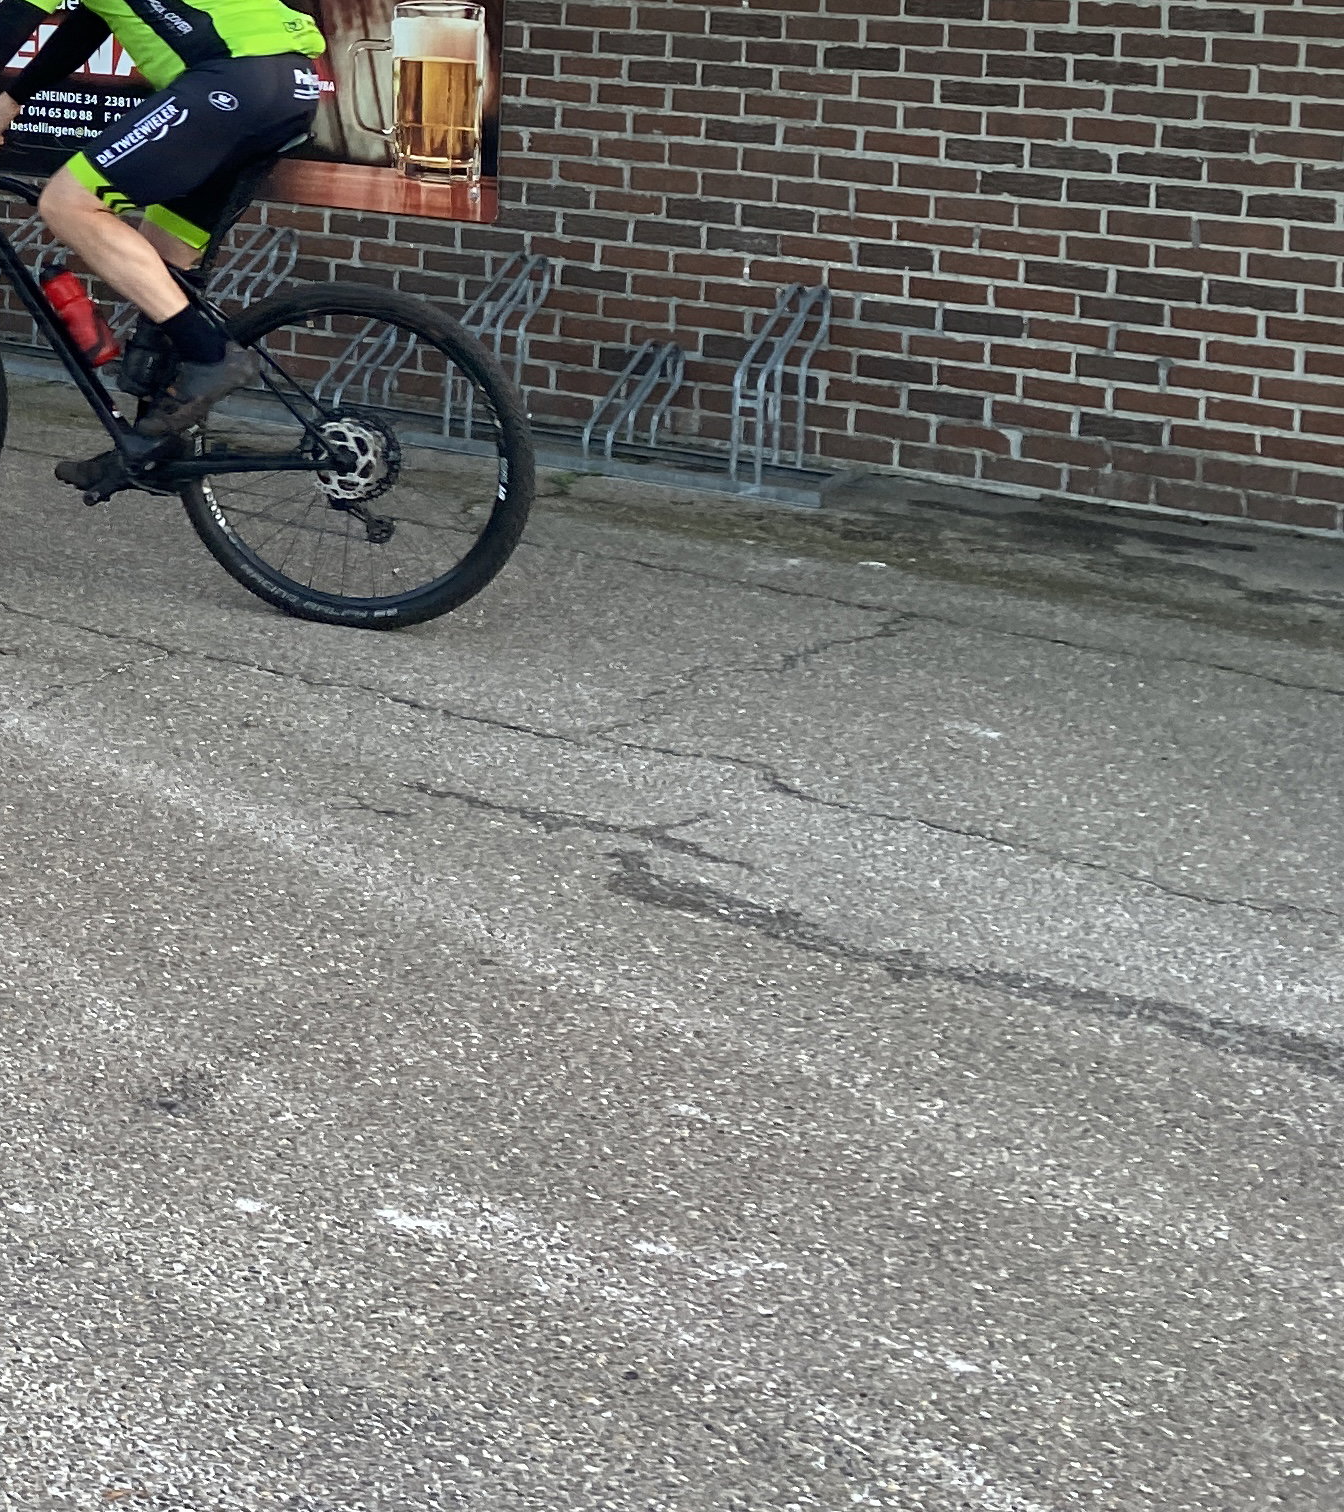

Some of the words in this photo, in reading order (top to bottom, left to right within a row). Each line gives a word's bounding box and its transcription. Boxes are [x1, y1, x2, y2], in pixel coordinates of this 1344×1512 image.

[30, 90, 83, 104] ENEINDE
[84, 93, 98, 105] 34
[104, 95, 131, 108] 2381
[28, 105, 47, 117] 014
[48, 107, 62, 119] 65
[63, 108, 78, 120] 80
[78, 109, 93, 121] 88
[96, 149, 116, 165] DE
[111, 104, 180, 153] TWEEWIELER
